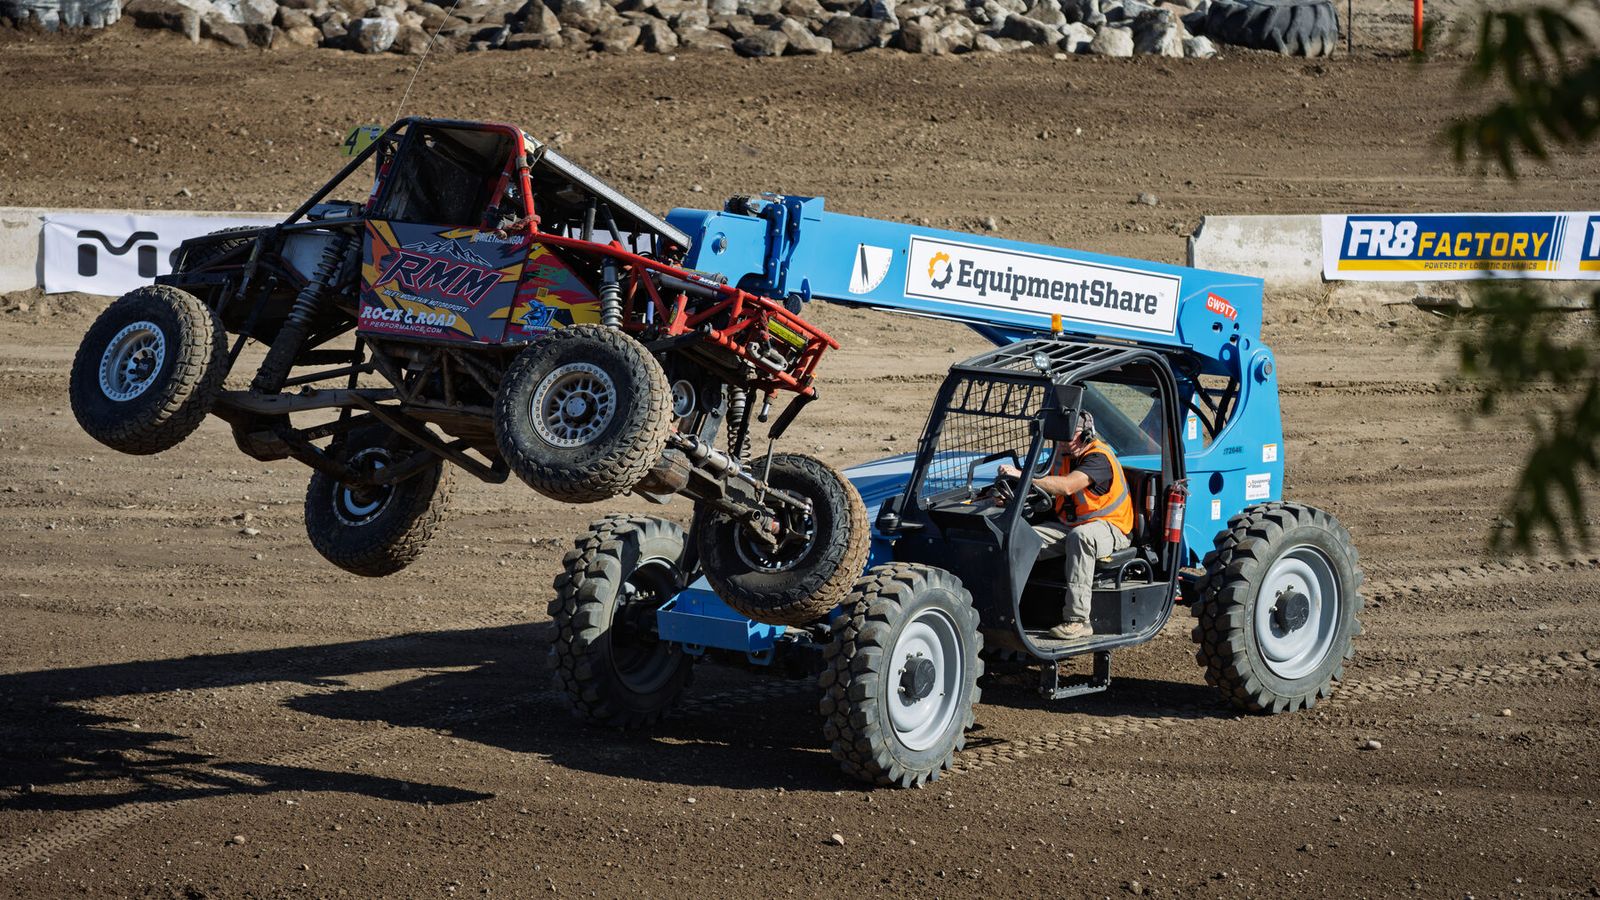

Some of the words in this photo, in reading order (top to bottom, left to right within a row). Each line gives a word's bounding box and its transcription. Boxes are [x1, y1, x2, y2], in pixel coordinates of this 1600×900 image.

[1347, 220, 1418, 257] FR8
[1417, 232, 1549, 257] FACTORY
[376, 250, 503, 305] RMM
[1423, 261, 1457, 269] POWERED
[1458, 261, 1468, 269] BY
[956, 258, 1158, 315] EquipmentShare
[360, 305, 402, 321] ROCK
[404, 307, 413, 324] &
[416, 310, 457, 327] ROAD
[428, 299, 470, 313] MOTORSPORTS
